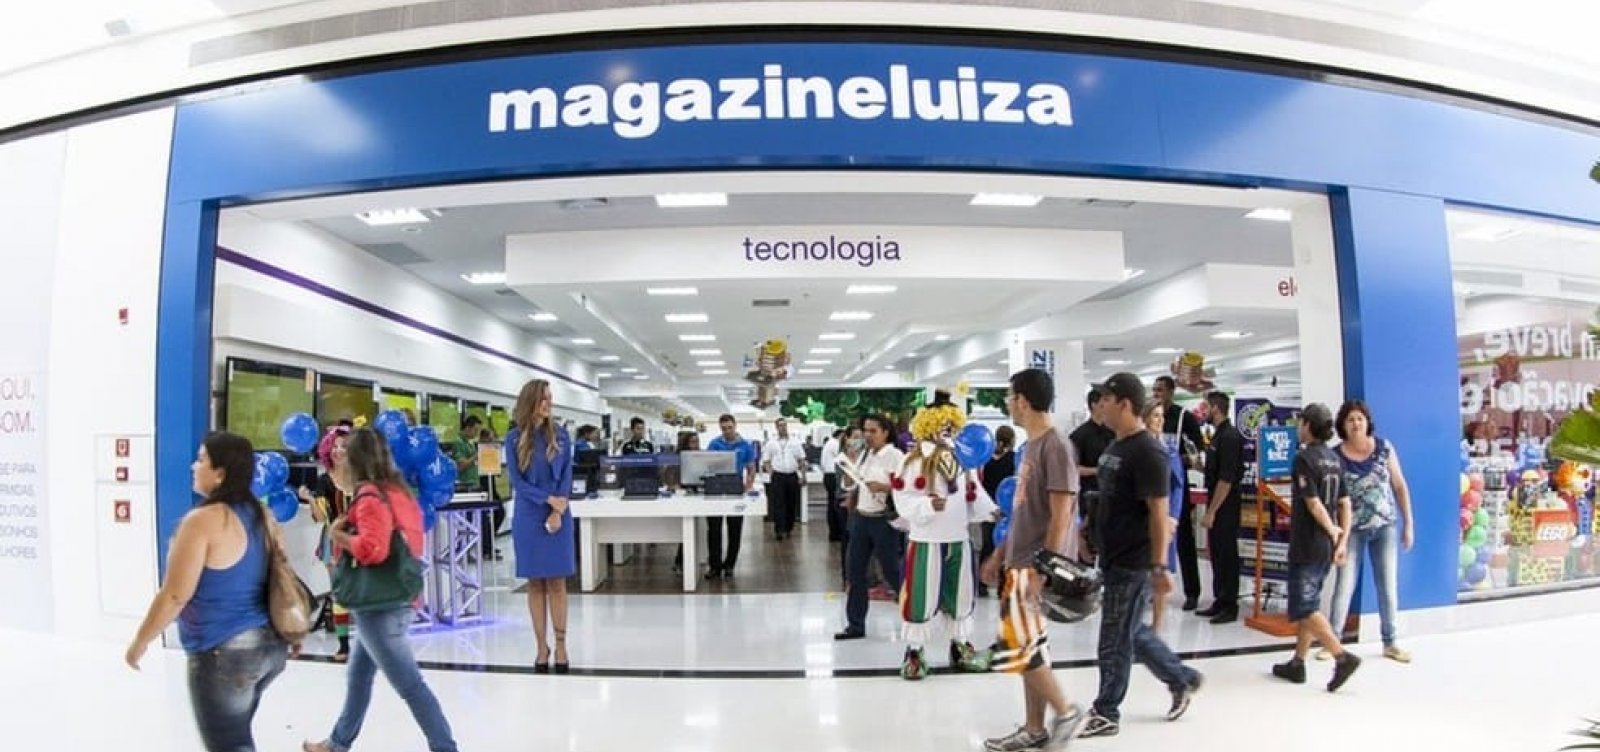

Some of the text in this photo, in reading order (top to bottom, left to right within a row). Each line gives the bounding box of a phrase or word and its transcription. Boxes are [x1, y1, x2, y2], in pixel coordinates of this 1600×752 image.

[488, 63, 1074, 139] magazineluiza
[742, 235, 901, 267] tecnologia
[1029, 349, 1047, 369] iz
